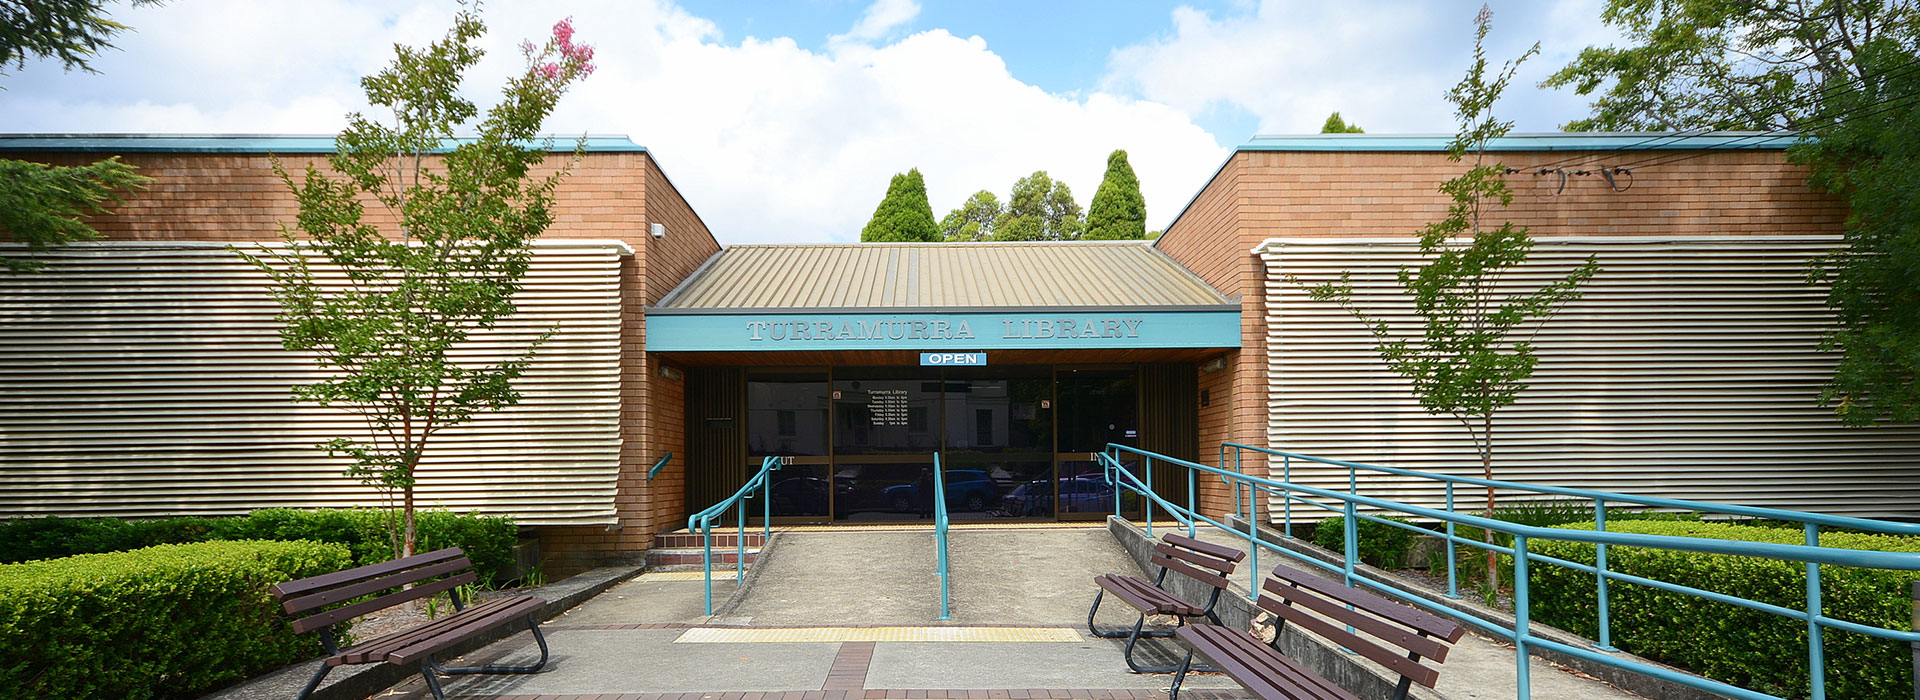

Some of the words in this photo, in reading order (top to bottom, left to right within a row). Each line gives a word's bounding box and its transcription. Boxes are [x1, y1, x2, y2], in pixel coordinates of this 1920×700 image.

[746, 319, 975, 341] TURRAMURRA
[1002, 318, 1143, 339] LIBRARY
[928, 353, 978, 365] OPEN
[775, 456, 795, 465] UT
